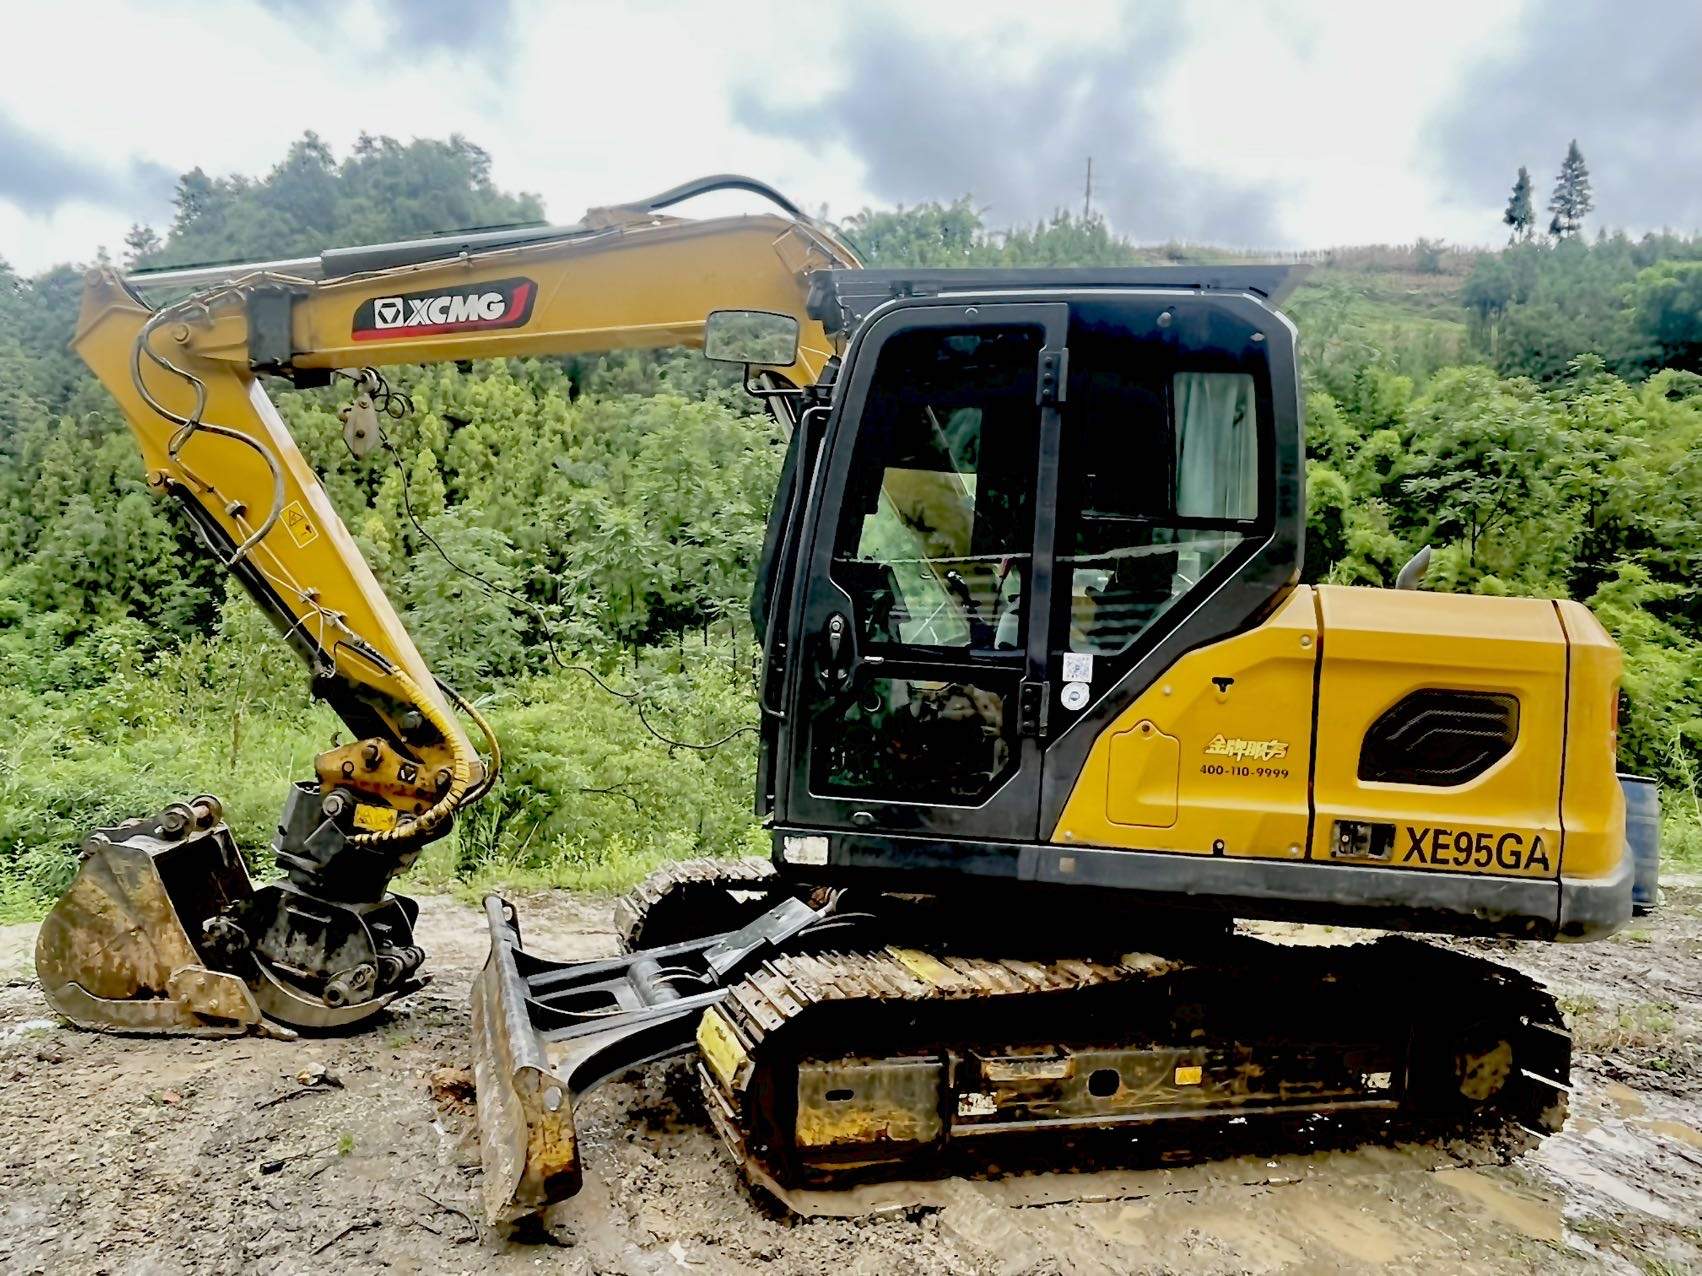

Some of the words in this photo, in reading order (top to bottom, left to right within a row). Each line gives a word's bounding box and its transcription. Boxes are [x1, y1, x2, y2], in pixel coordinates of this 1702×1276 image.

[404, 292, 506, 327] XCMG
[1200, 764, 1289, 779] 400-110-9999
[1403, 827, 1550, 872] XE95GA
